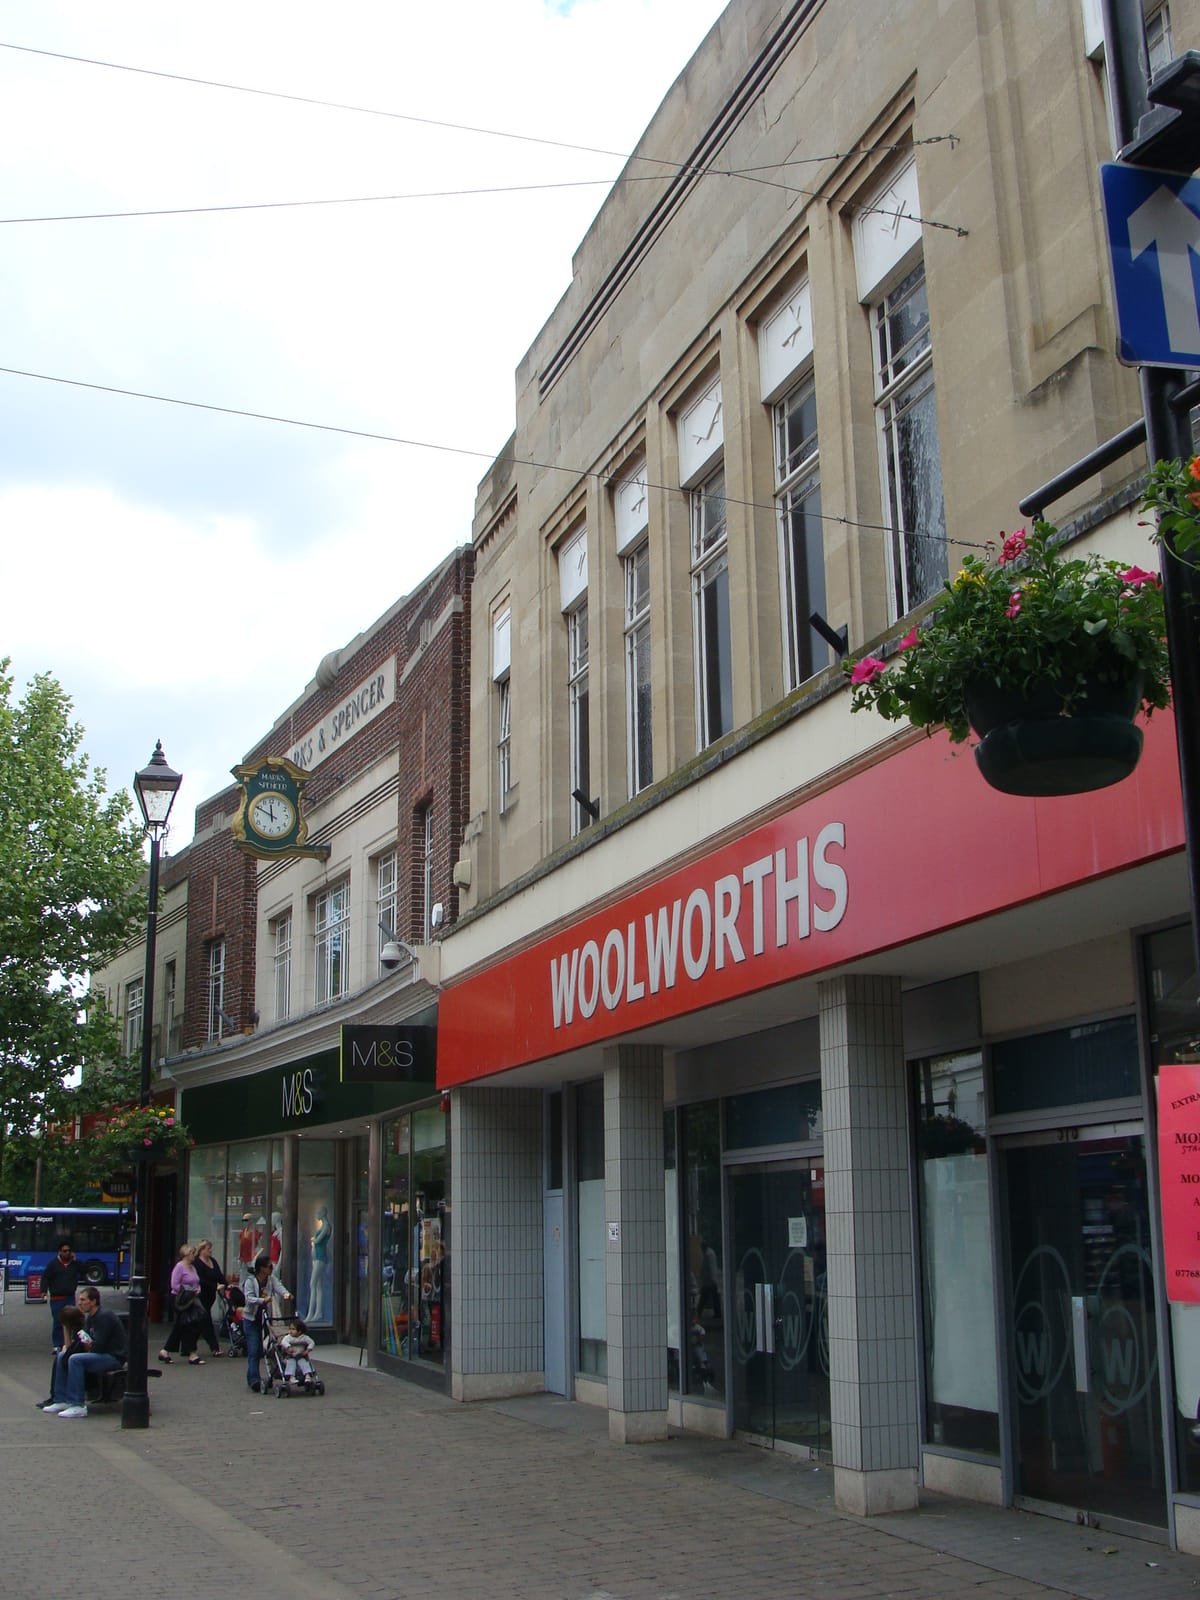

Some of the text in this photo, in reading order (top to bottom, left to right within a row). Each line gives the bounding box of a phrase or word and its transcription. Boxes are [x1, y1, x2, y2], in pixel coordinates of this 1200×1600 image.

[292, 674, 385, 769] RKS & SPENCER
[550, 822, 849, 1029] WOOLWORTHS
[351, 1040, 414, 1067] M&S
[282, 1068, 313, 1118] M&S
[1175, 1132, 1200, 1144] MO
[783, 1314, 799, 1349] W
[1016, 1330, 1047, 1376] W
[1101, 1338, 1134, 1387] W
